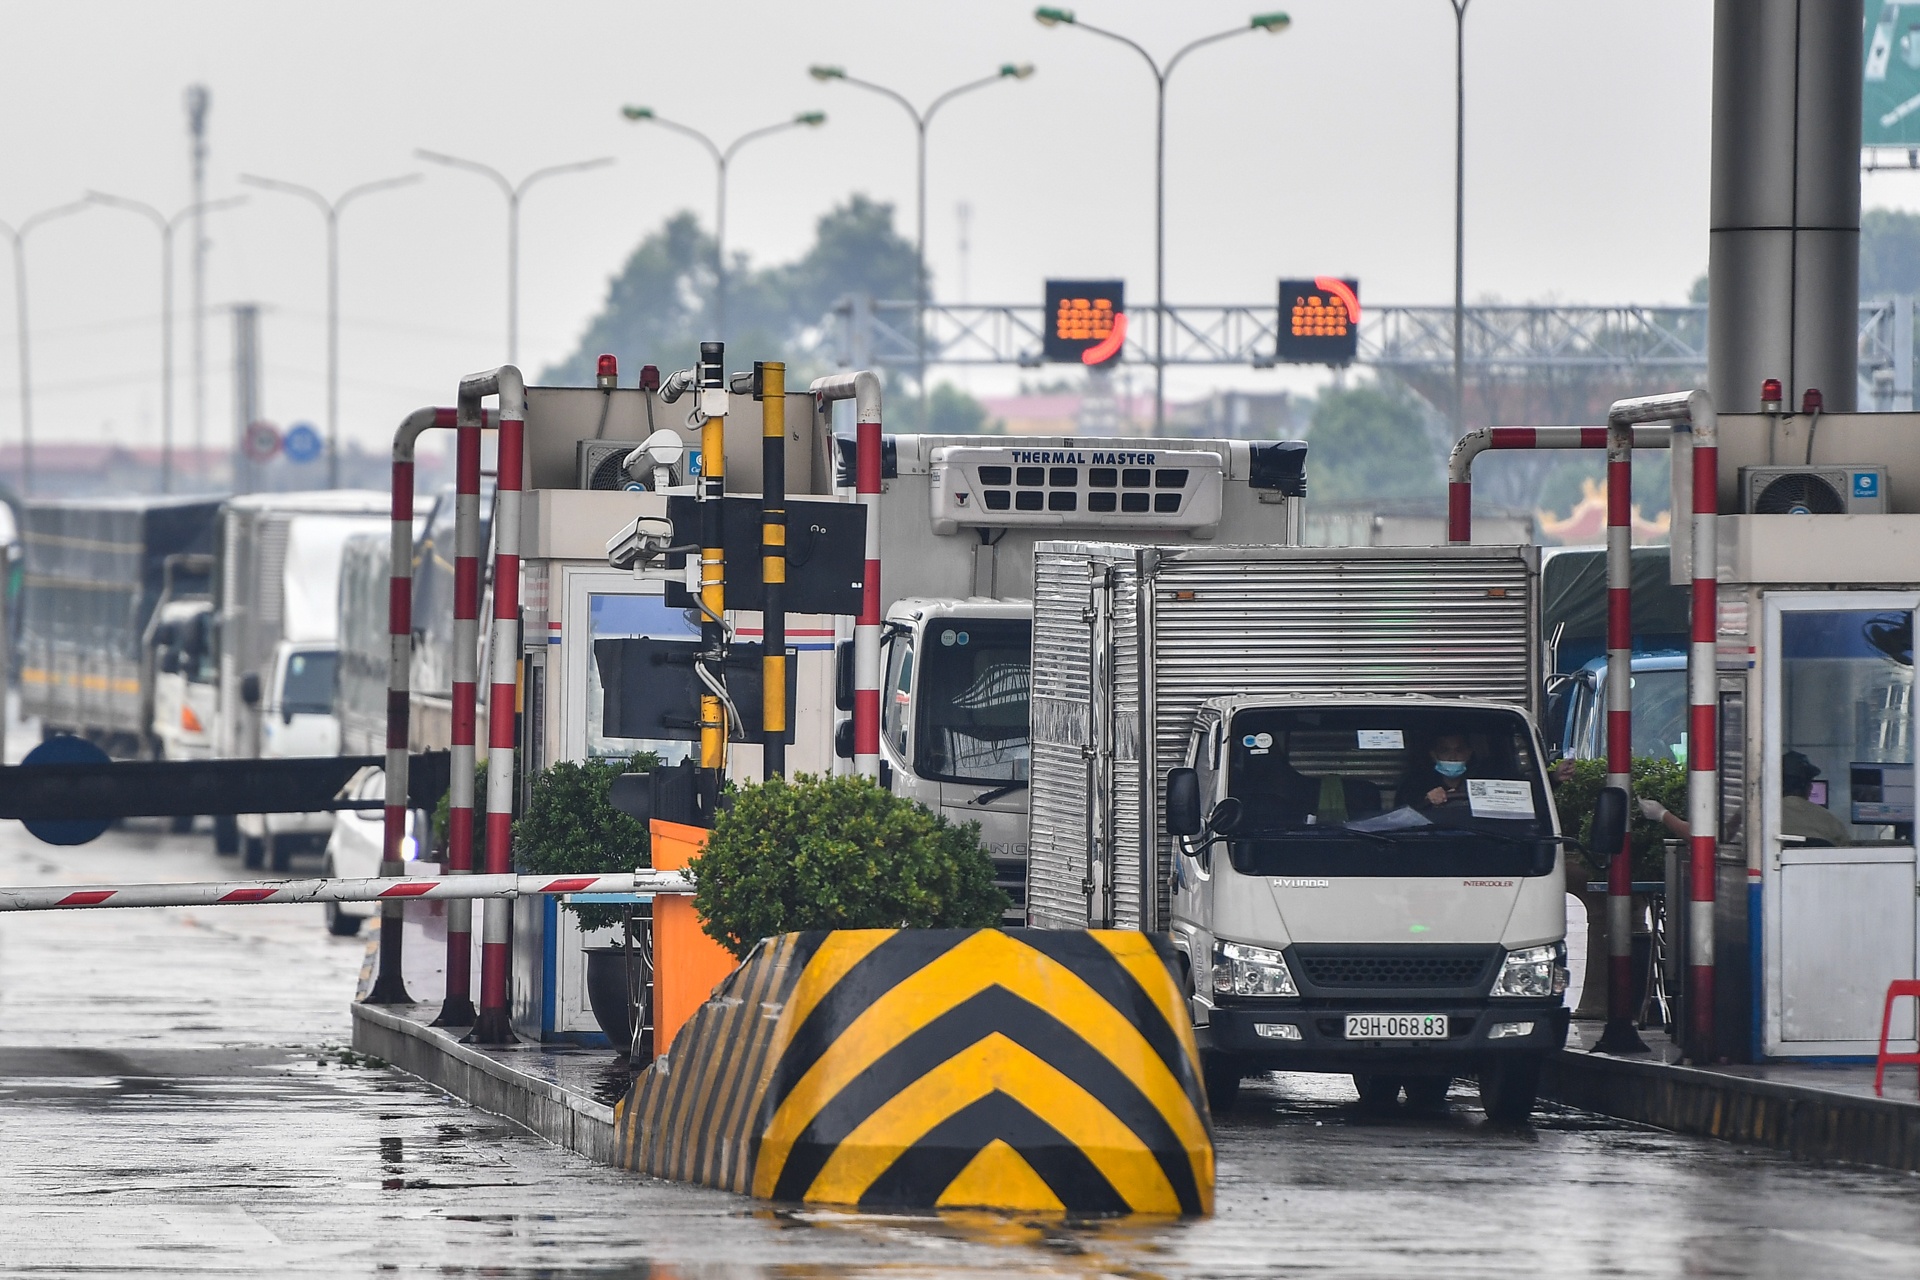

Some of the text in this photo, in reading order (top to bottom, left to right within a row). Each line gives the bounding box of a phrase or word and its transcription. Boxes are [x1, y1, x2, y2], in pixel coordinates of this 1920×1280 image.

[1012, 451, 1156, 465] THERMAL MASTER
[1273, 879, 1329, 888] HYUNDAI
[1348, 1017, 1445, 1036] 29H-068.83
